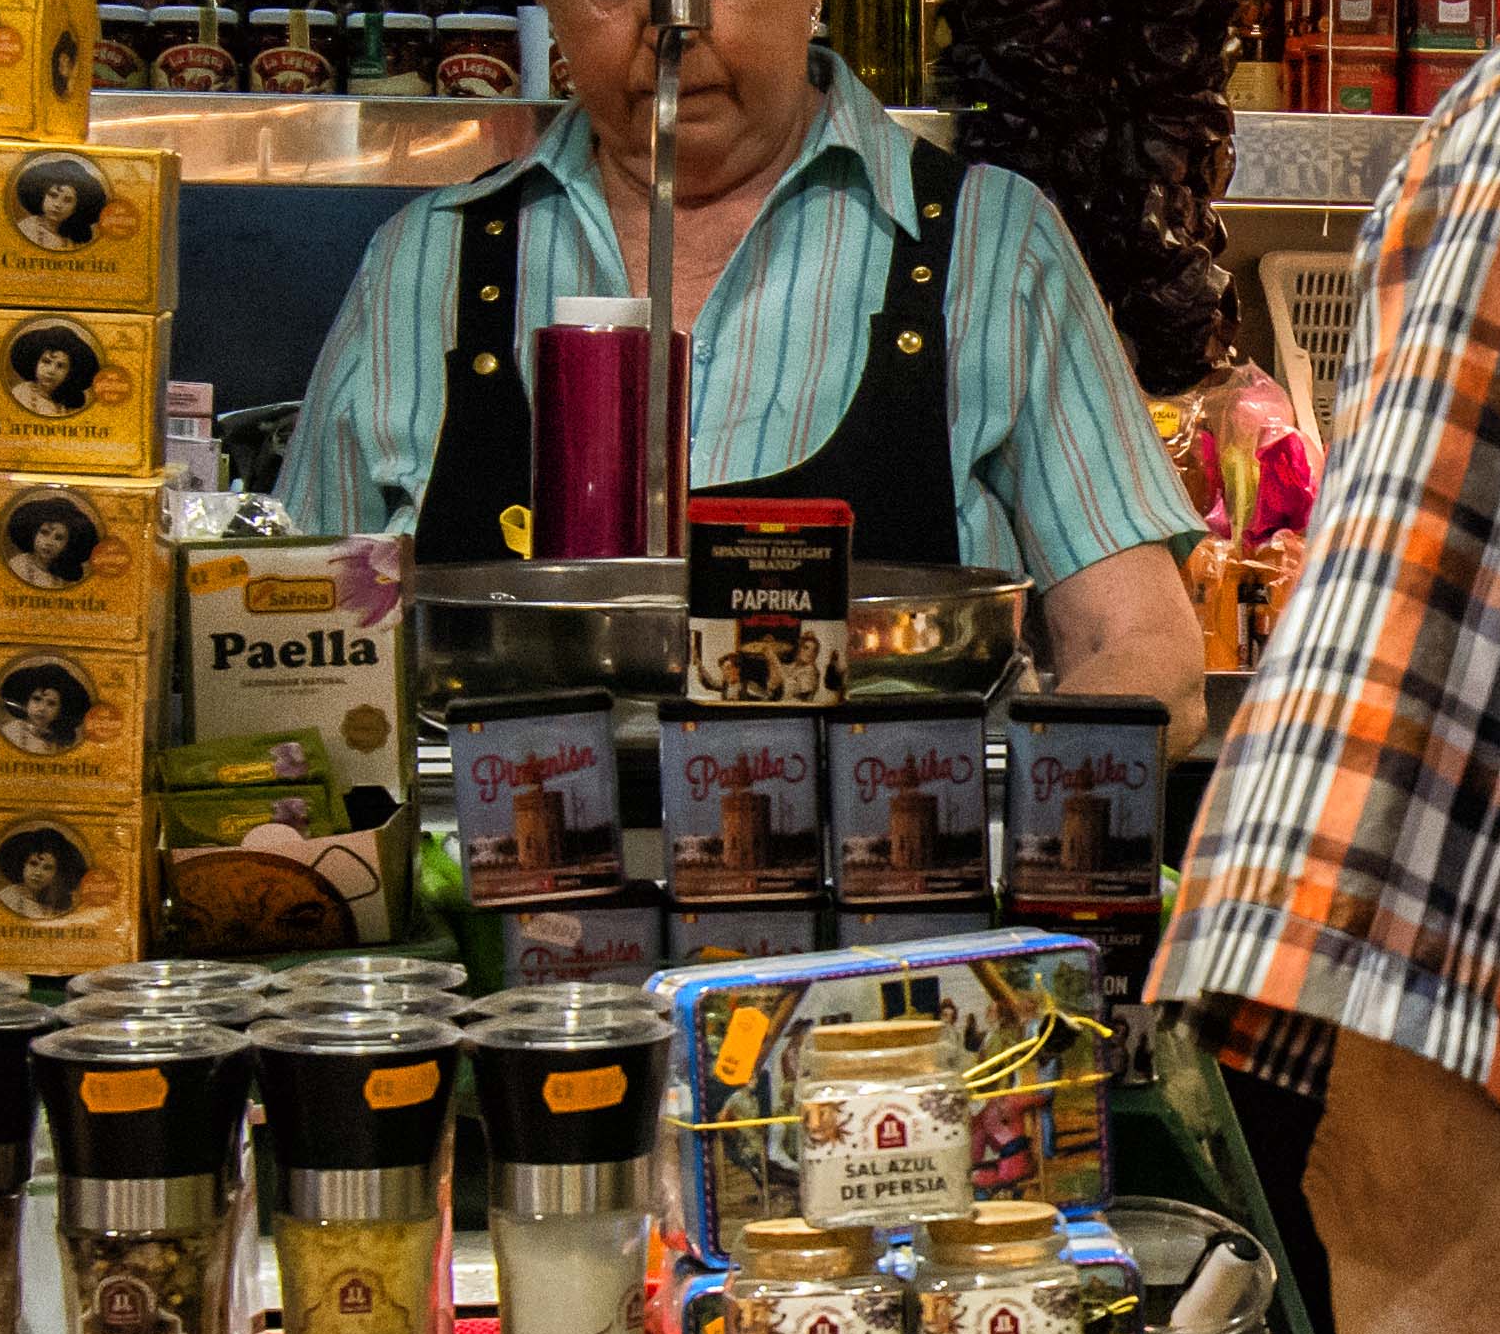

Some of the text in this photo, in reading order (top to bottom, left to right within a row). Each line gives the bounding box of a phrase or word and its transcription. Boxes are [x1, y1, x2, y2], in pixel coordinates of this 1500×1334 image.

[0, 249, 118, 275] Carmencita
[731, 588, 812, 612] PAPRIKA
[211, 628, 379, 672] Paella
[686, 750, 809, 801] Paprika
[855, 750, 974, 803] Paprika
[844, 1155, 937, 1179] SAL AZUL
[840, 1174, 948, 1202] DE PERSIA
